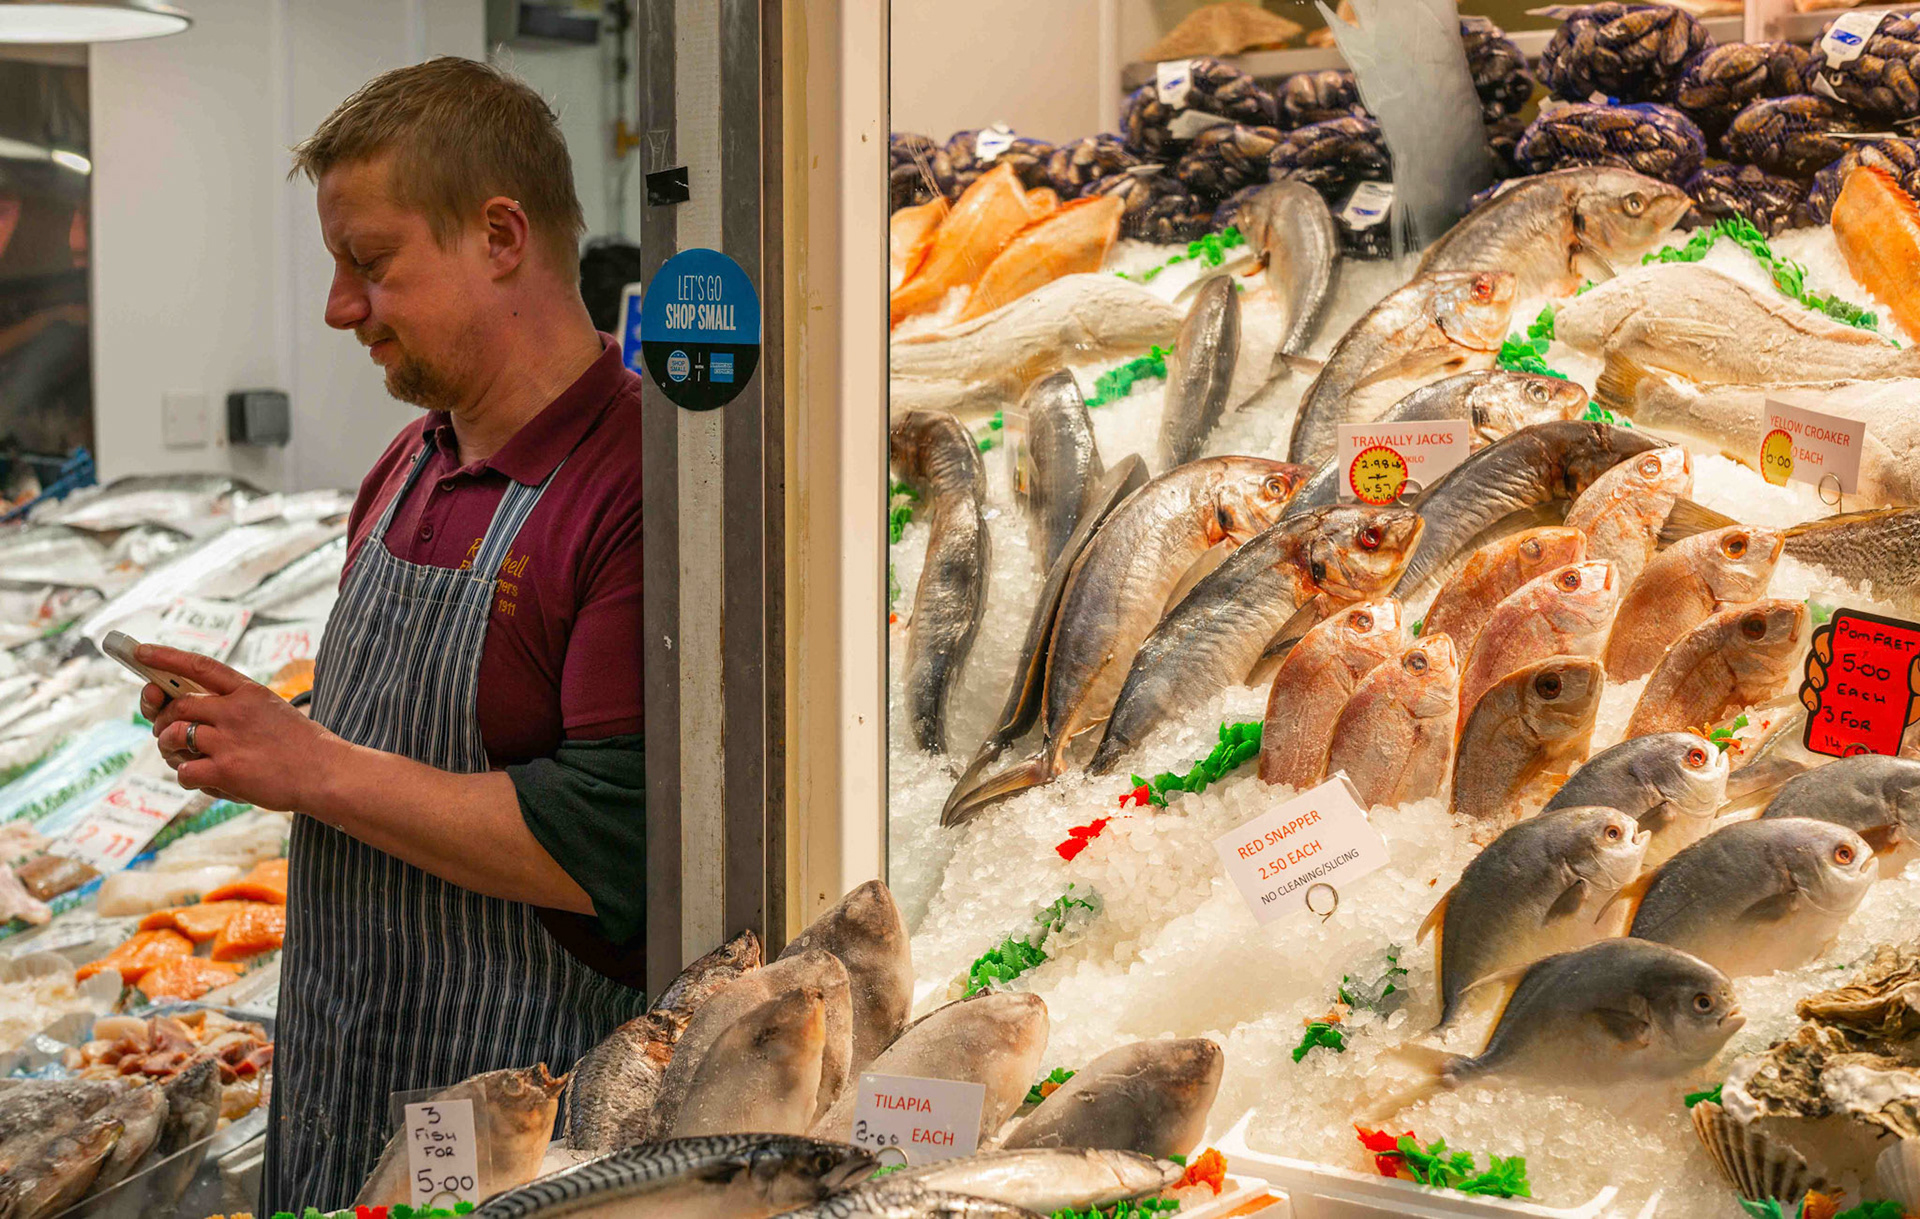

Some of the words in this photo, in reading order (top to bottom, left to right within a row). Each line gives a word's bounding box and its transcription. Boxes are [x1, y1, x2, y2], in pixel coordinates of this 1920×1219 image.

[678, 275, 705, 301] LET'S
[707, 275, 722, 301] GO
[665, 303, 696, 329] SHOP
[698, 304, 736, 331] SMALL
[1352, 434, 1412, 447] TRAVALLY
[1416, 433, 1453, 445] JACKS
[1769, 415, 1803, 434] YELLOW
[1804, 425, 1850, 447] CROAKER
[1361, 459, 1389, 469] 2.98
[1799, 448, 1824, 465] EACH
[498, 599, 517, 617] 1911
[1837, 683, 1886, 704] EACH
[1823, 705, 1835, 723] 3
[1841, 711, 1872, 732] FOR
[1237, 839, 1265, 860] RED
[1264, 810, 1322, 847] SNAPPER
[1258, 857, 1288, 880] 2.50
[1287, 839, 1323, 865] EACH
[1261, 891, 1277, 905] NO
[1277, 848, 1360, 897] CLEANING/SLICING
[875, 1093, 932, 1113] TILAPIA
[421, 1107, 441, 1124] 3
[911, 1128, 955, 1146] EACH
[423, 1146, 456, 1158] FOR
